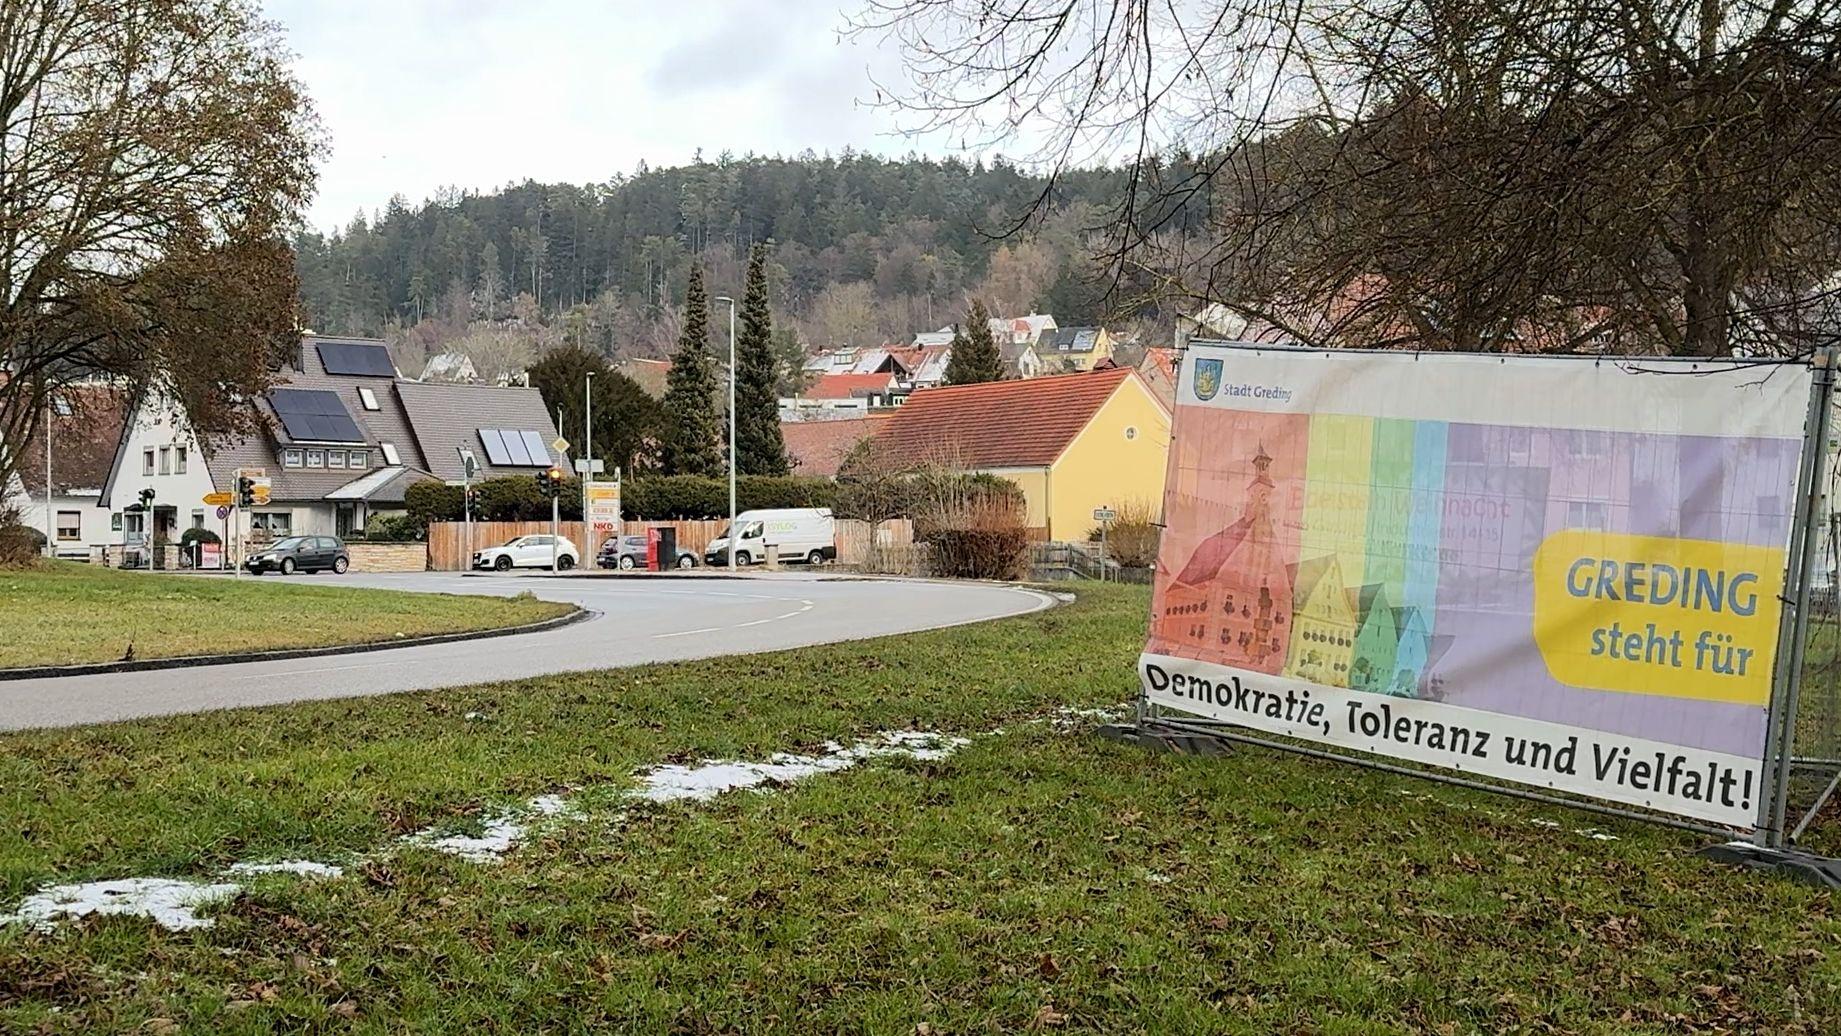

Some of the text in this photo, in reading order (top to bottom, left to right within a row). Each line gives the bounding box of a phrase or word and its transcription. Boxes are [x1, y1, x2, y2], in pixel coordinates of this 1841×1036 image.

[1224, 383, 1293, 403] Stadt Greding
[1567, 557, 1759, 617] GREDING
[1590, 622, 1754, 677] steht für
[1145, 663, 1753, 811] Demokratie, Toleranz und Vielfalt!
